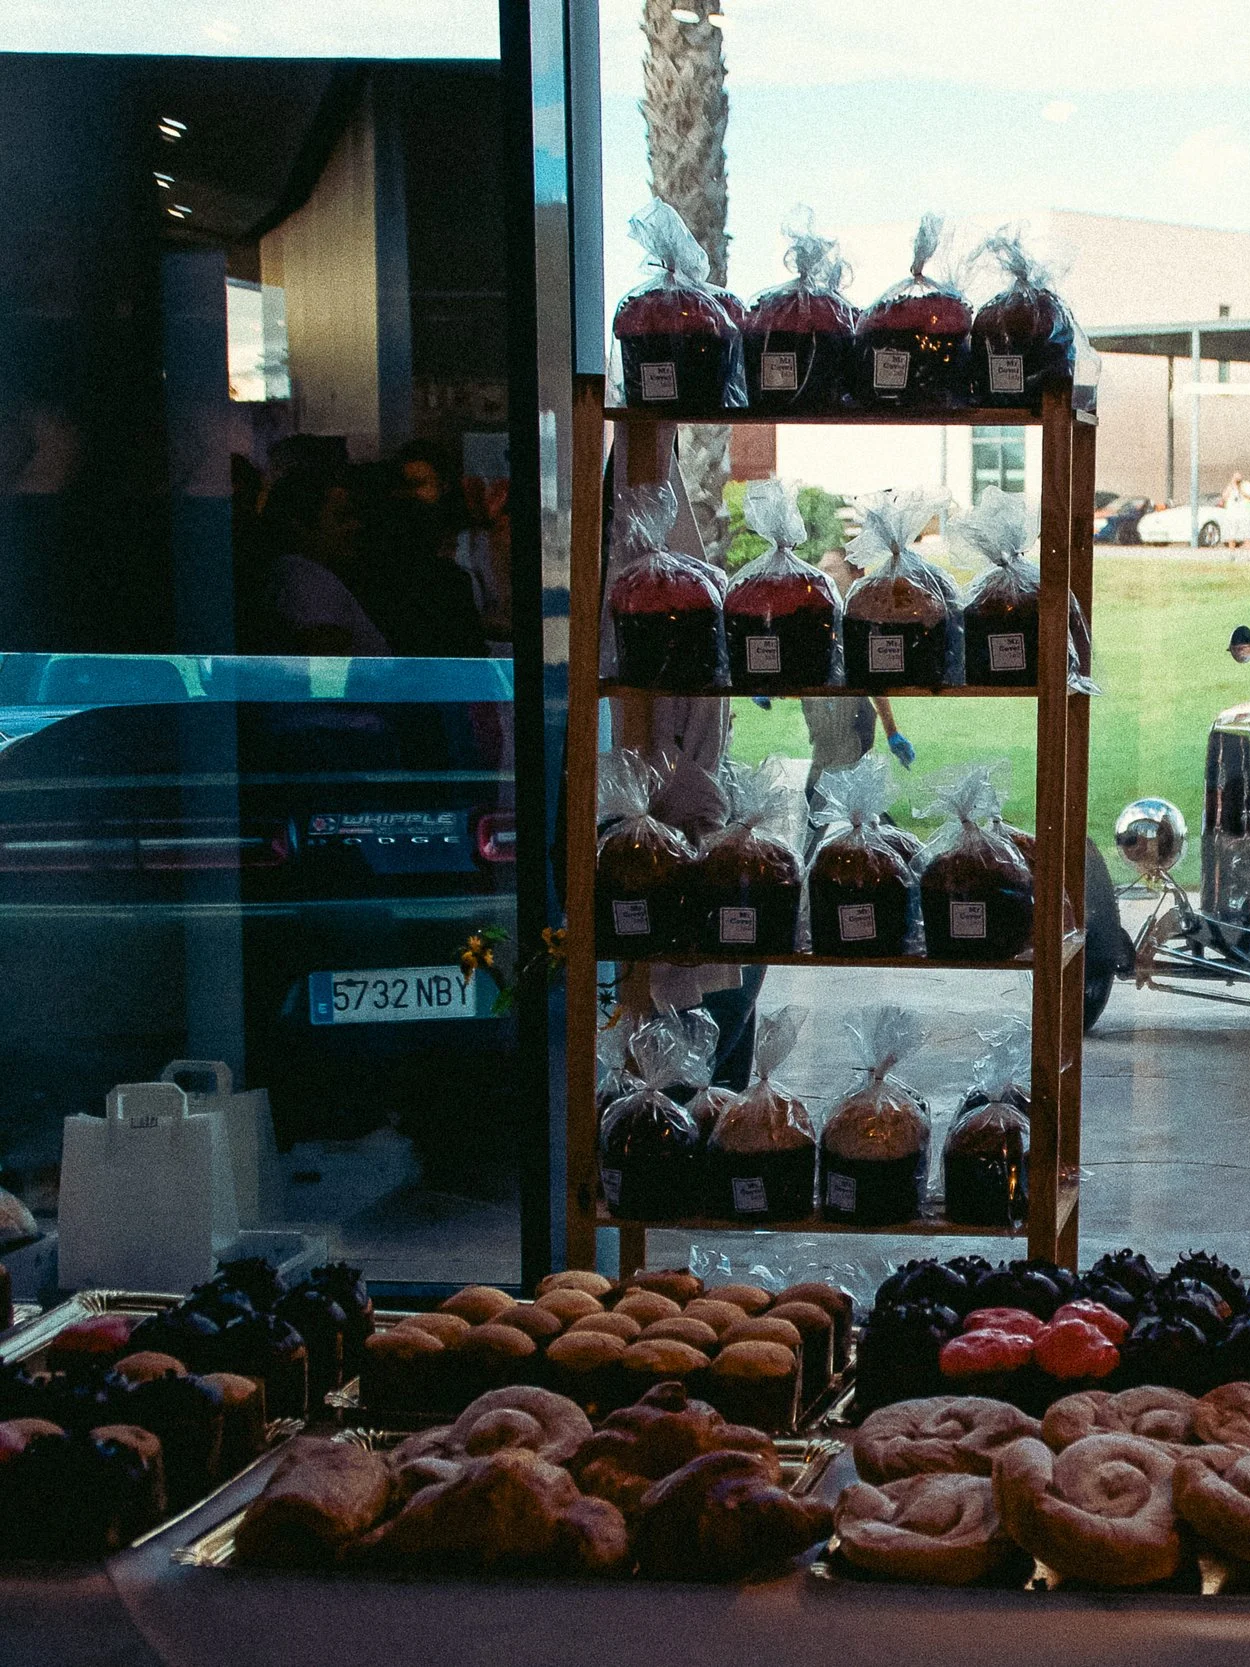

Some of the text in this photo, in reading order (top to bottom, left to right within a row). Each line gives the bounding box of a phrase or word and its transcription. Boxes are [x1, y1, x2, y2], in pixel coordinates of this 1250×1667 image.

[343, 813, 454, 825] WHIPPLE
[333, 975, 469, 1011] 5732 NBY
